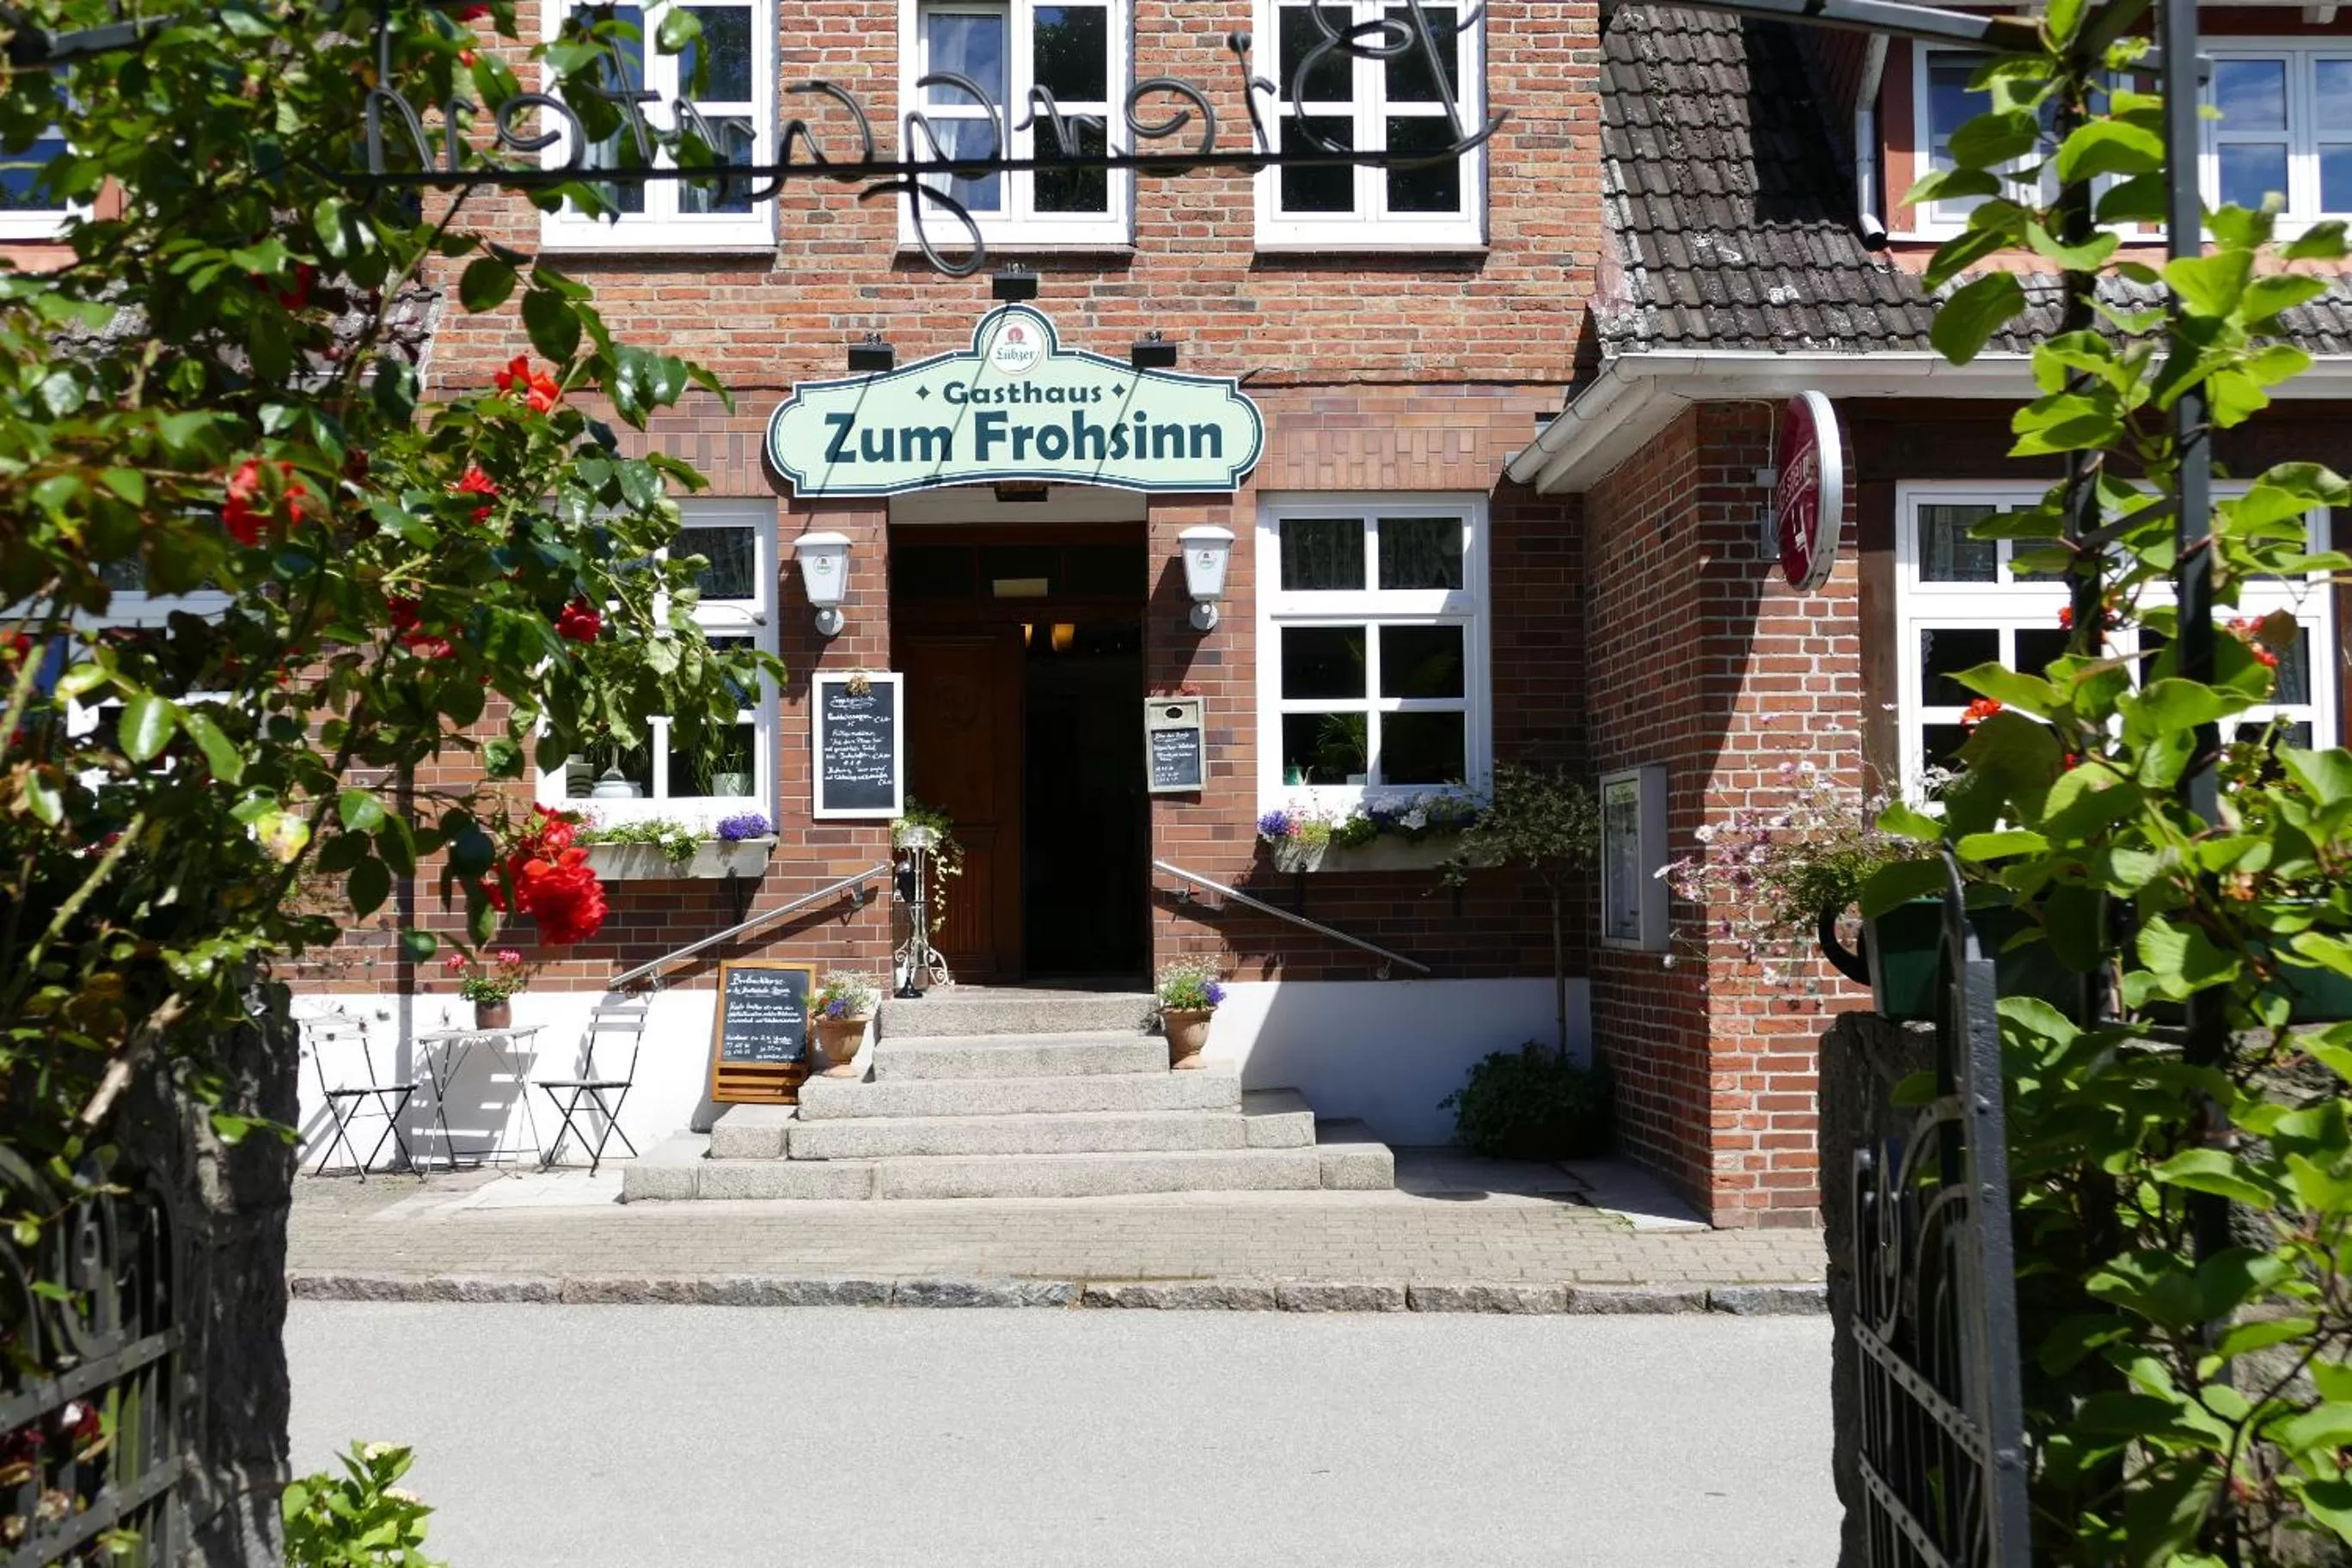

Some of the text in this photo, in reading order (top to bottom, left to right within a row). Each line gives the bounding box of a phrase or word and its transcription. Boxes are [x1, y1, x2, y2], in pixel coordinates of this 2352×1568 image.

[995, 347, 1036, 361] Lübzer
[943, 381, 1102, 404] Gasthaus
[824, 409, 1222, 462] Zum Frohsinn
